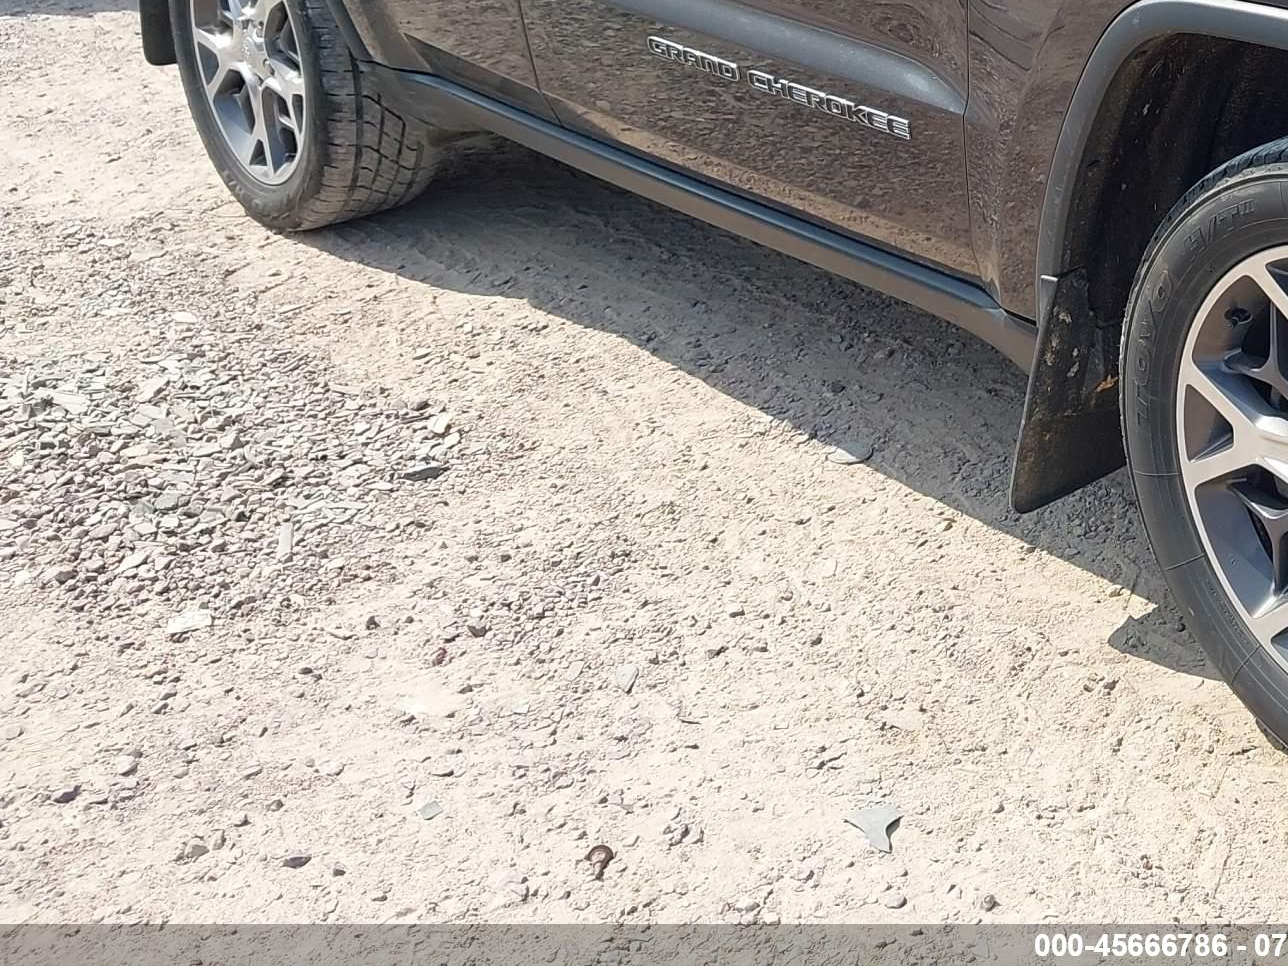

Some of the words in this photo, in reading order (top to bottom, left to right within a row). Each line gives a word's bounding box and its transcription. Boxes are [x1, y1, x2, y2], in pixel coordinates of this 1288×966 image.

[646, 35, 741, 81] GRAND
[747, 69, 913, 140] CHEROKEE
[1135, 268, 1173, 428] TOYO
